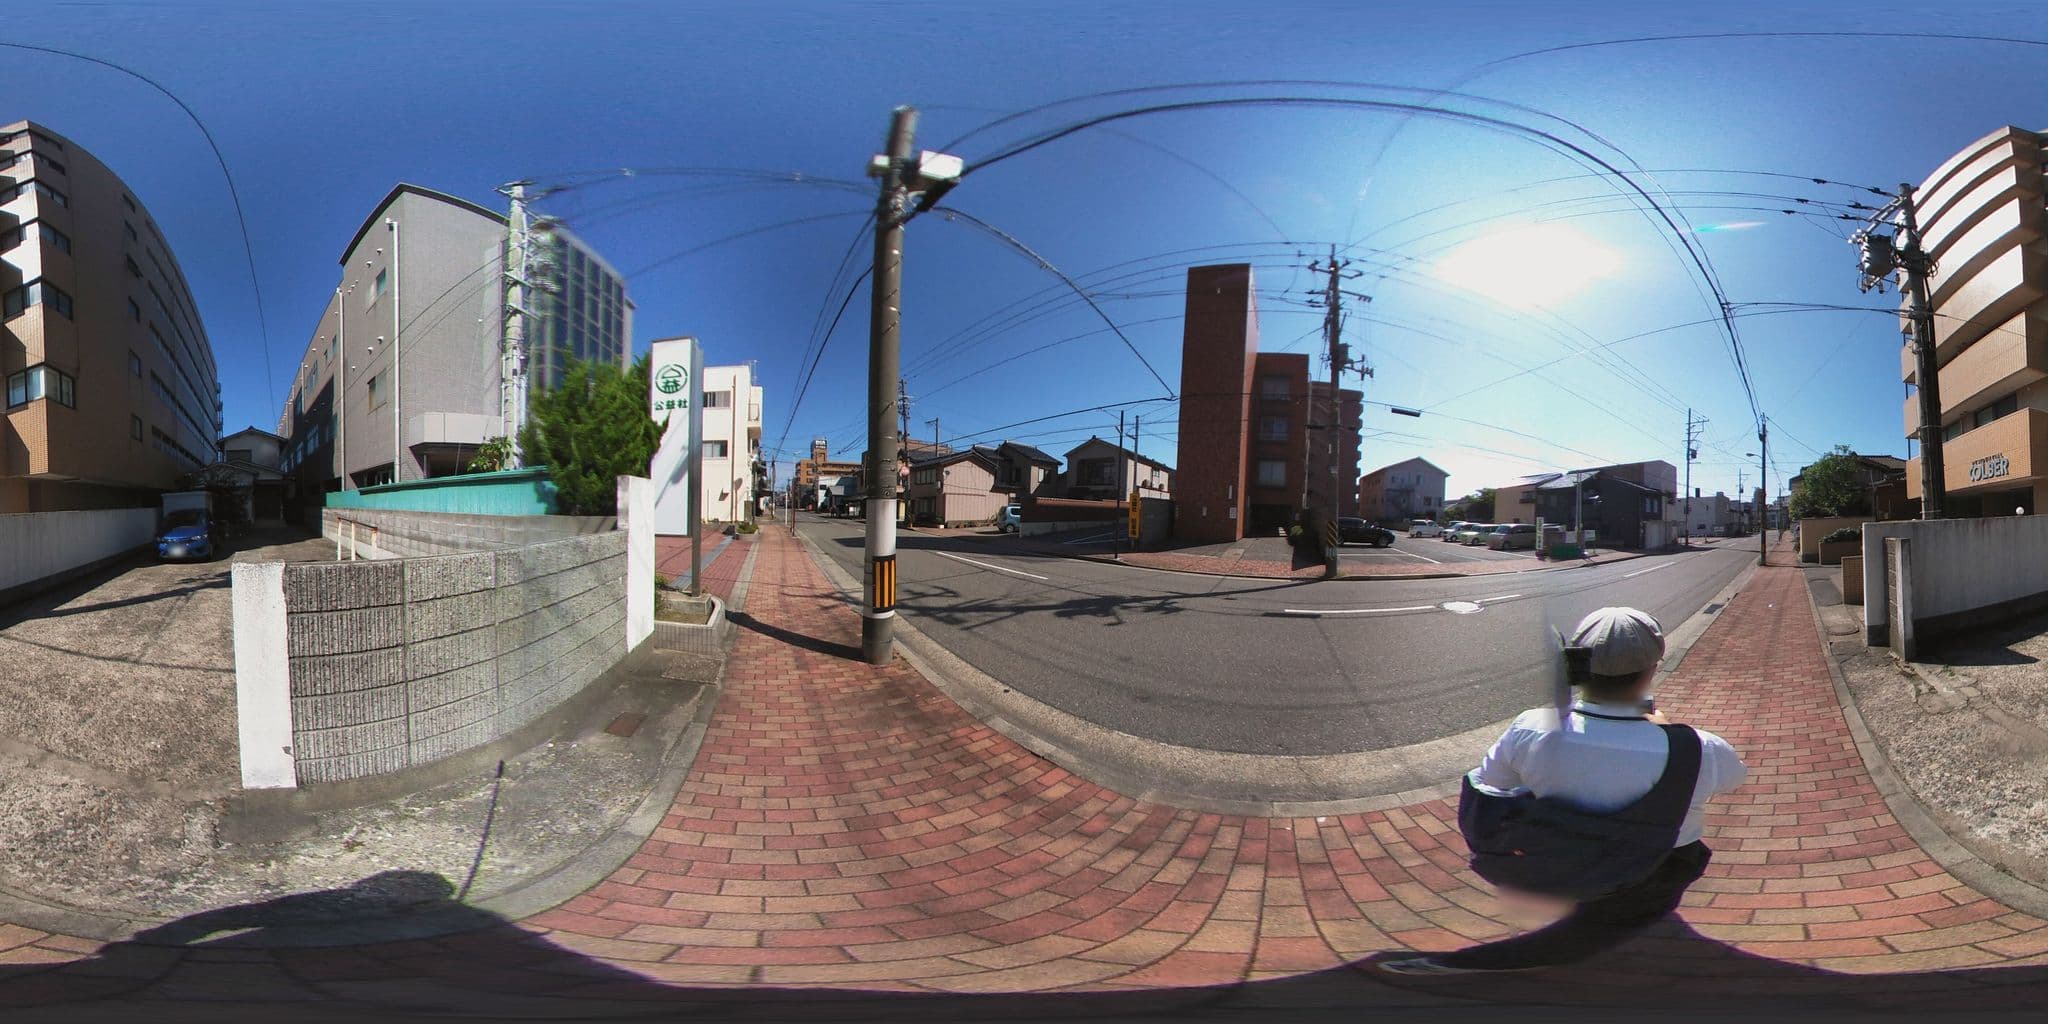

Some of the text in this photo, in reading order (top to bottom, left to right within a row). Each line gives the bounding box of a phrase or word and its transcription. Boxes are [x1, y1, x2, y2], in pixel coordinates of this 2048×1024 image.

[655, 398, 688, 411] 公益社
[1968, 458, 2009, 482] COLBER
